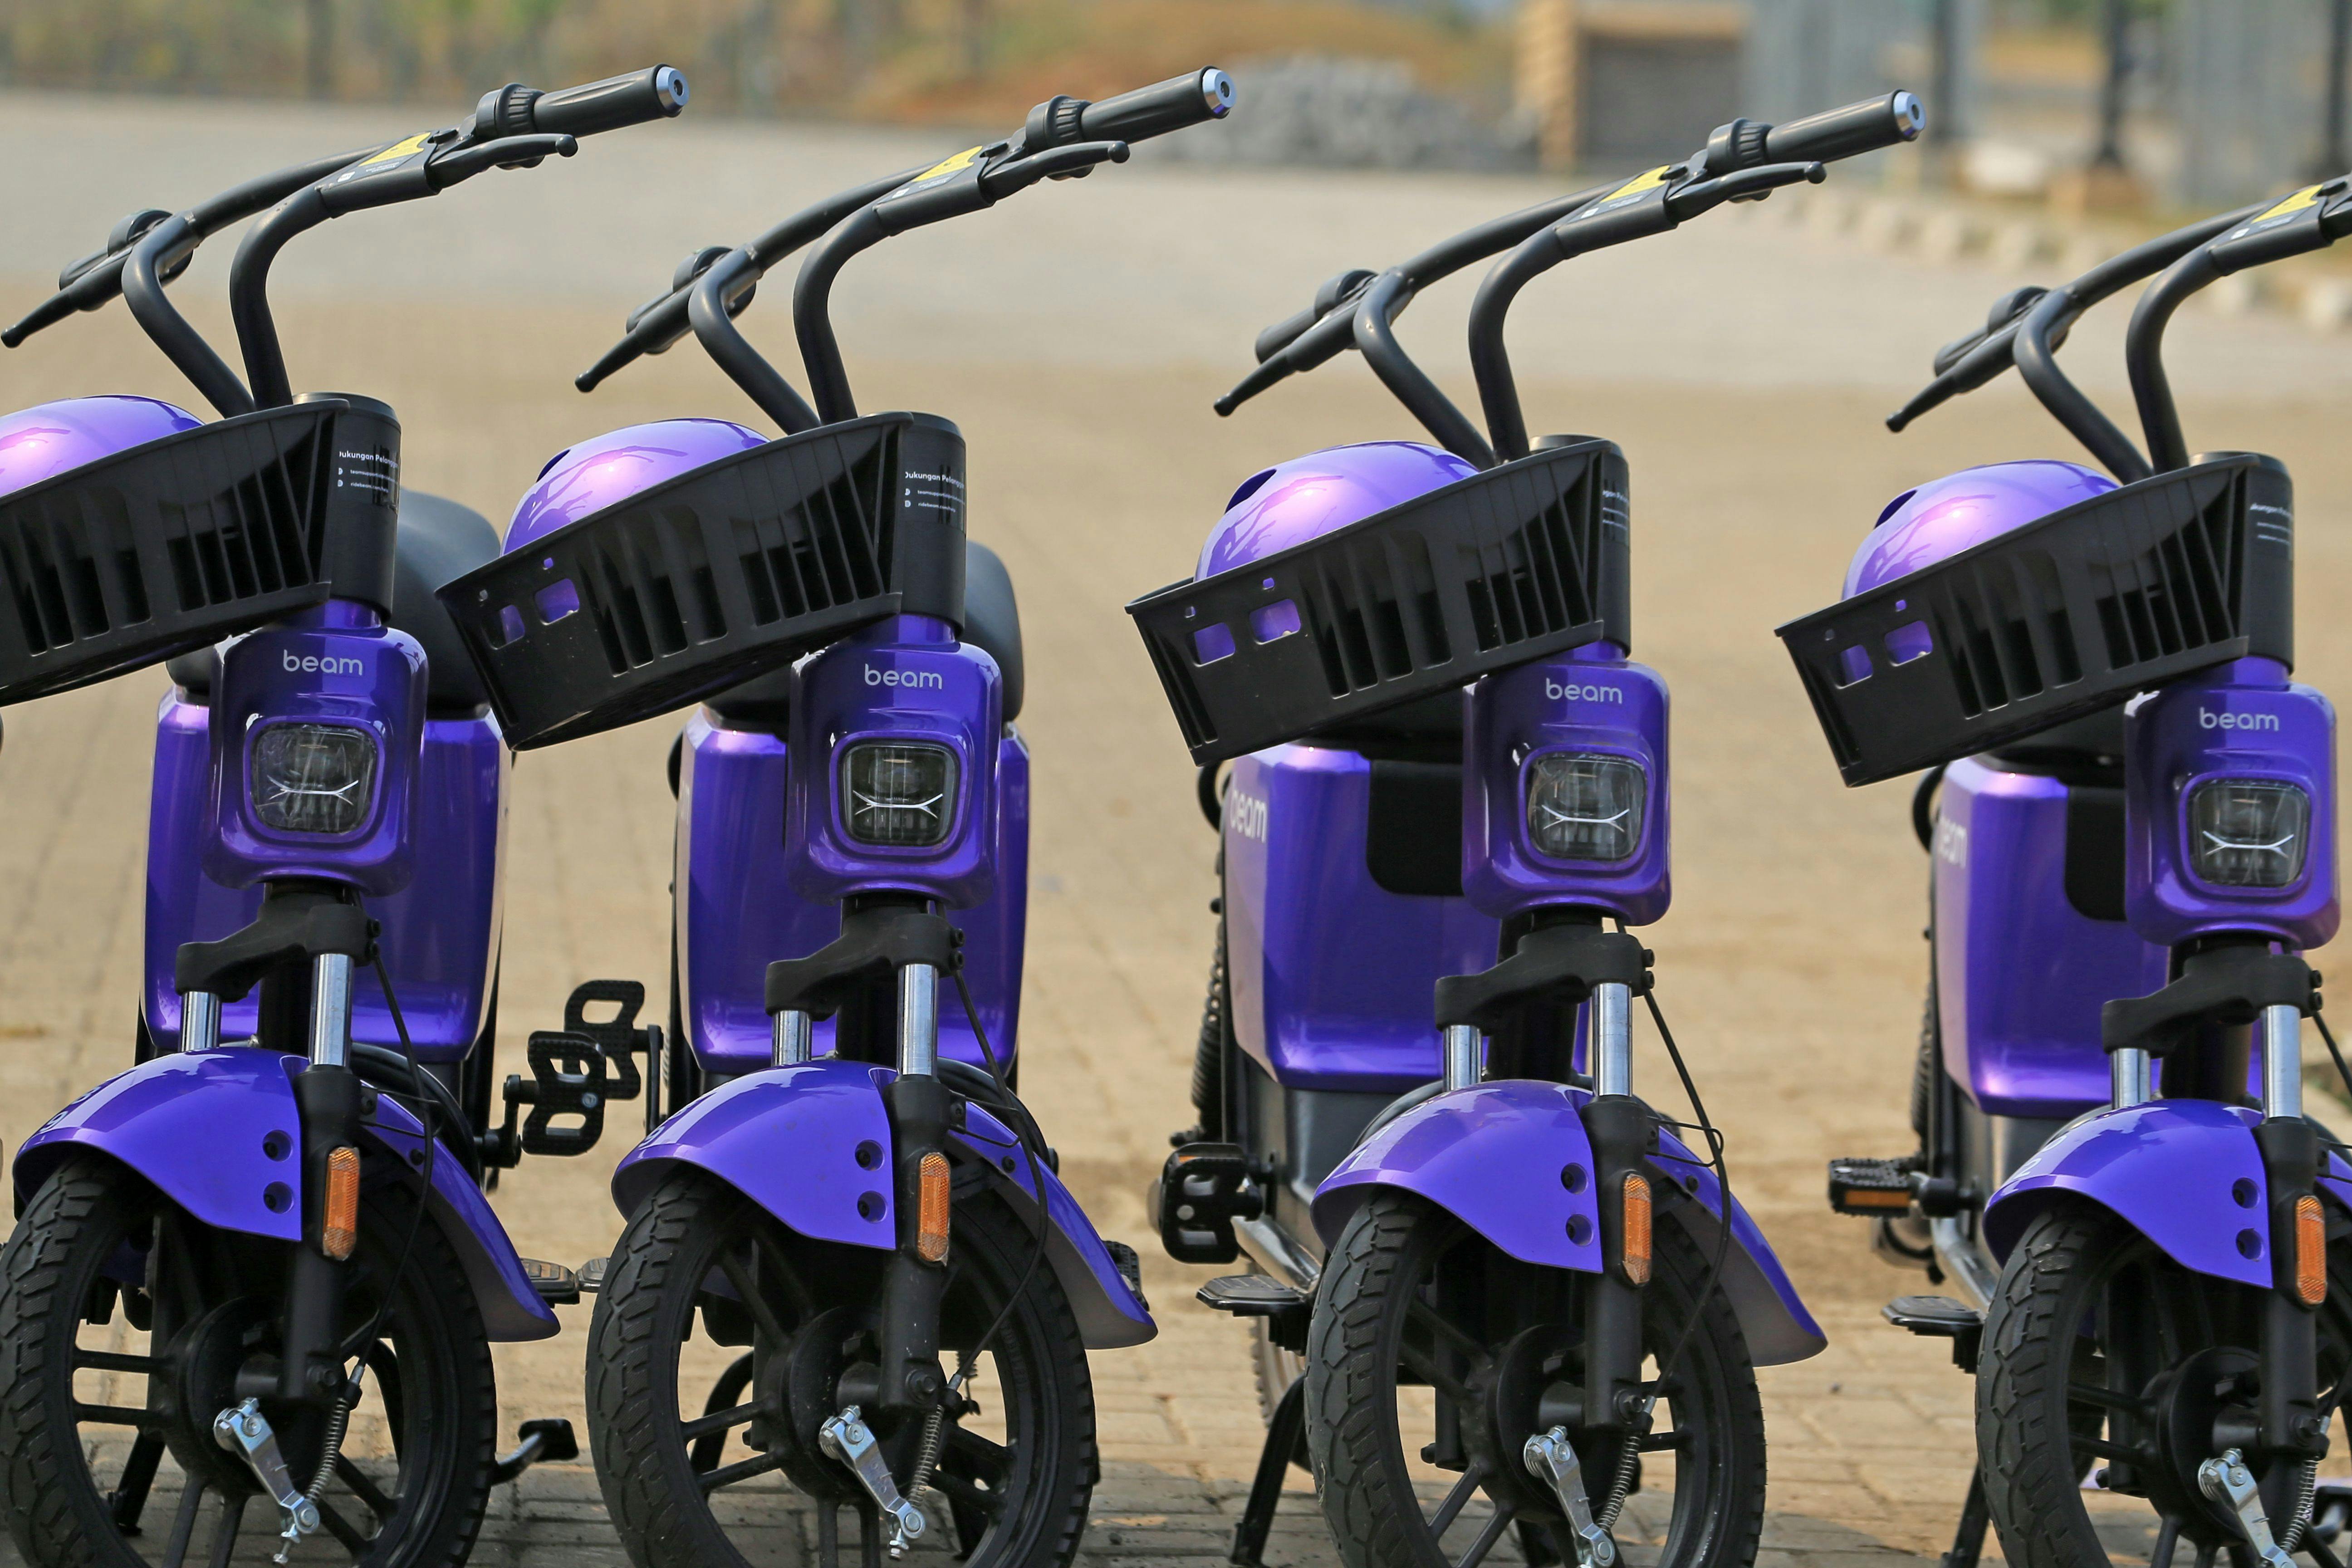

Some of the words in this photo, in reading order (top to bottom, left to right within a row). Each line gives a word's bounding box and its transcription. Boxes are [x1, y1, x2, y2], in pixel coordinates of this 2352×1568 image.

[283, 649, 363, 676] beam
[864, 663, 942, 690] beam
[1546, 677, 1622, 704] beam
[2200, 706, 2279, 731] beam
[1230, 789, 1268, 843] beam
